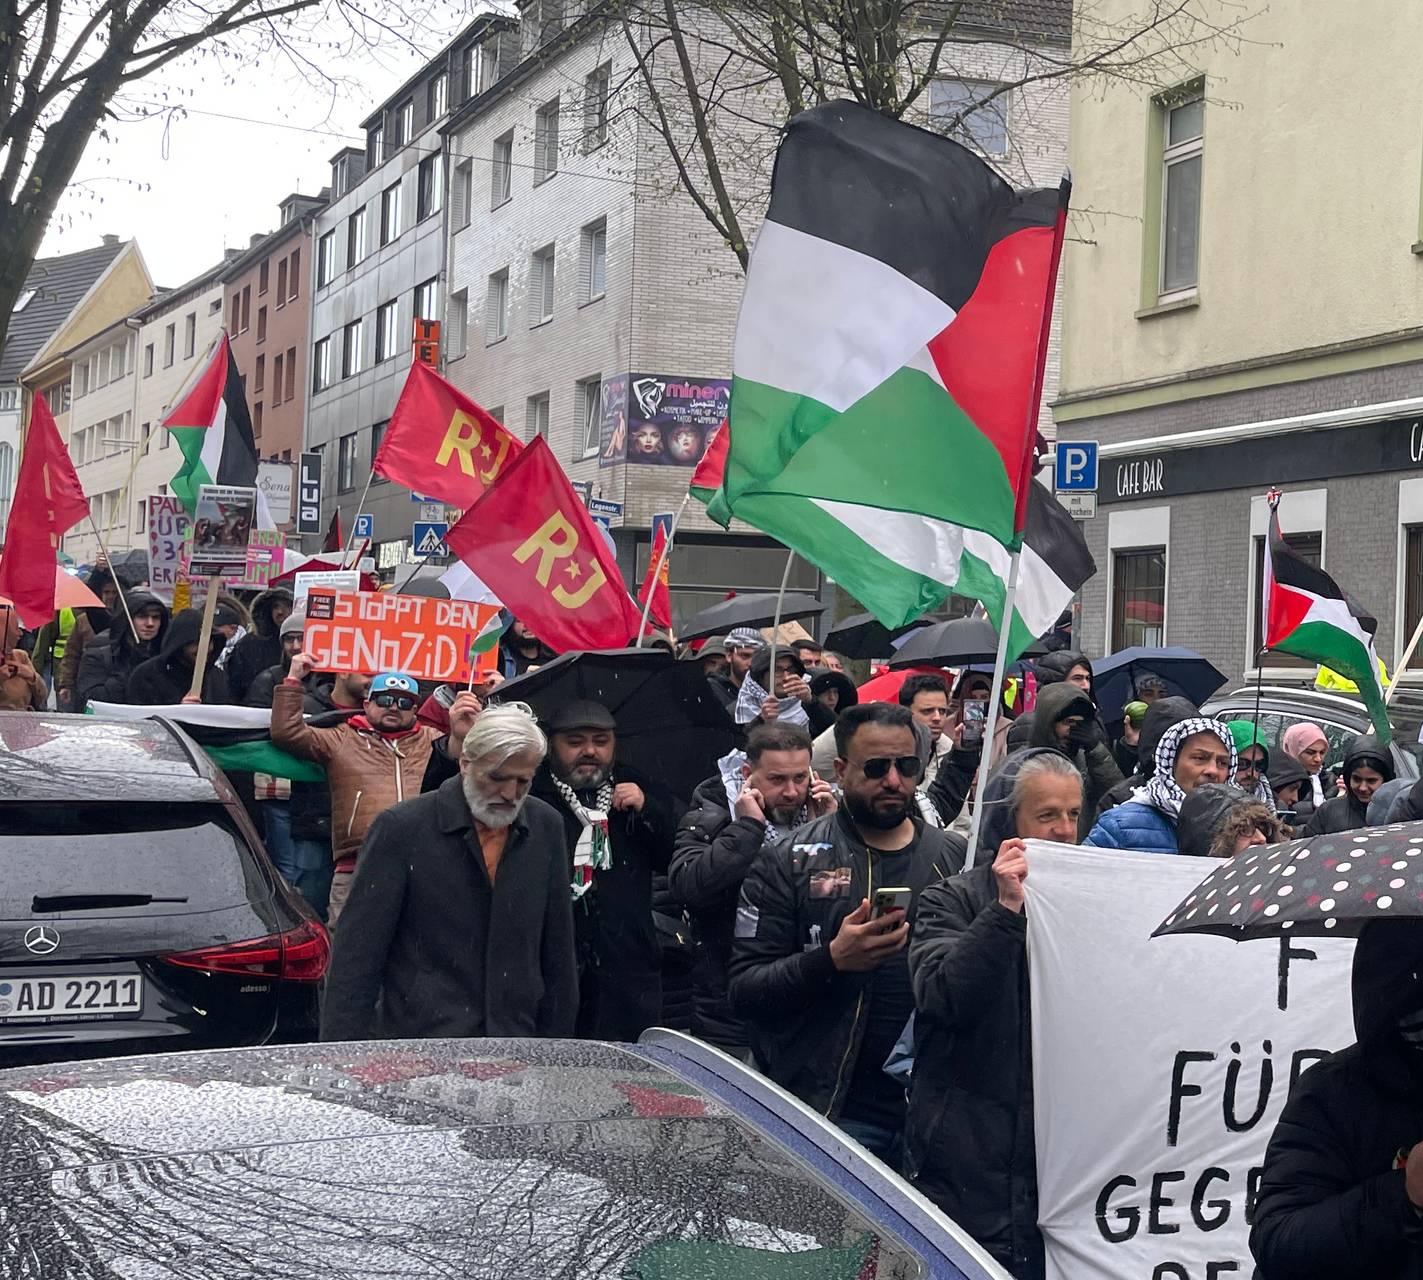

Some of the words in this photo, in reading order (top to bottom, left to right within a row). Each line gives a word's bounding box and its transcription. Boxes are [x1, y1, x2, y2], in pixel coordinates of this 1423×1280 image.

[1065, 448, 1088, 485] P
[1116, 462, 1140, 496] CAFE
[1142, 458, 1164, 493] BAR
[436, 602, 480, 630] DEN
[64, 978, 138, 1009] 2211
